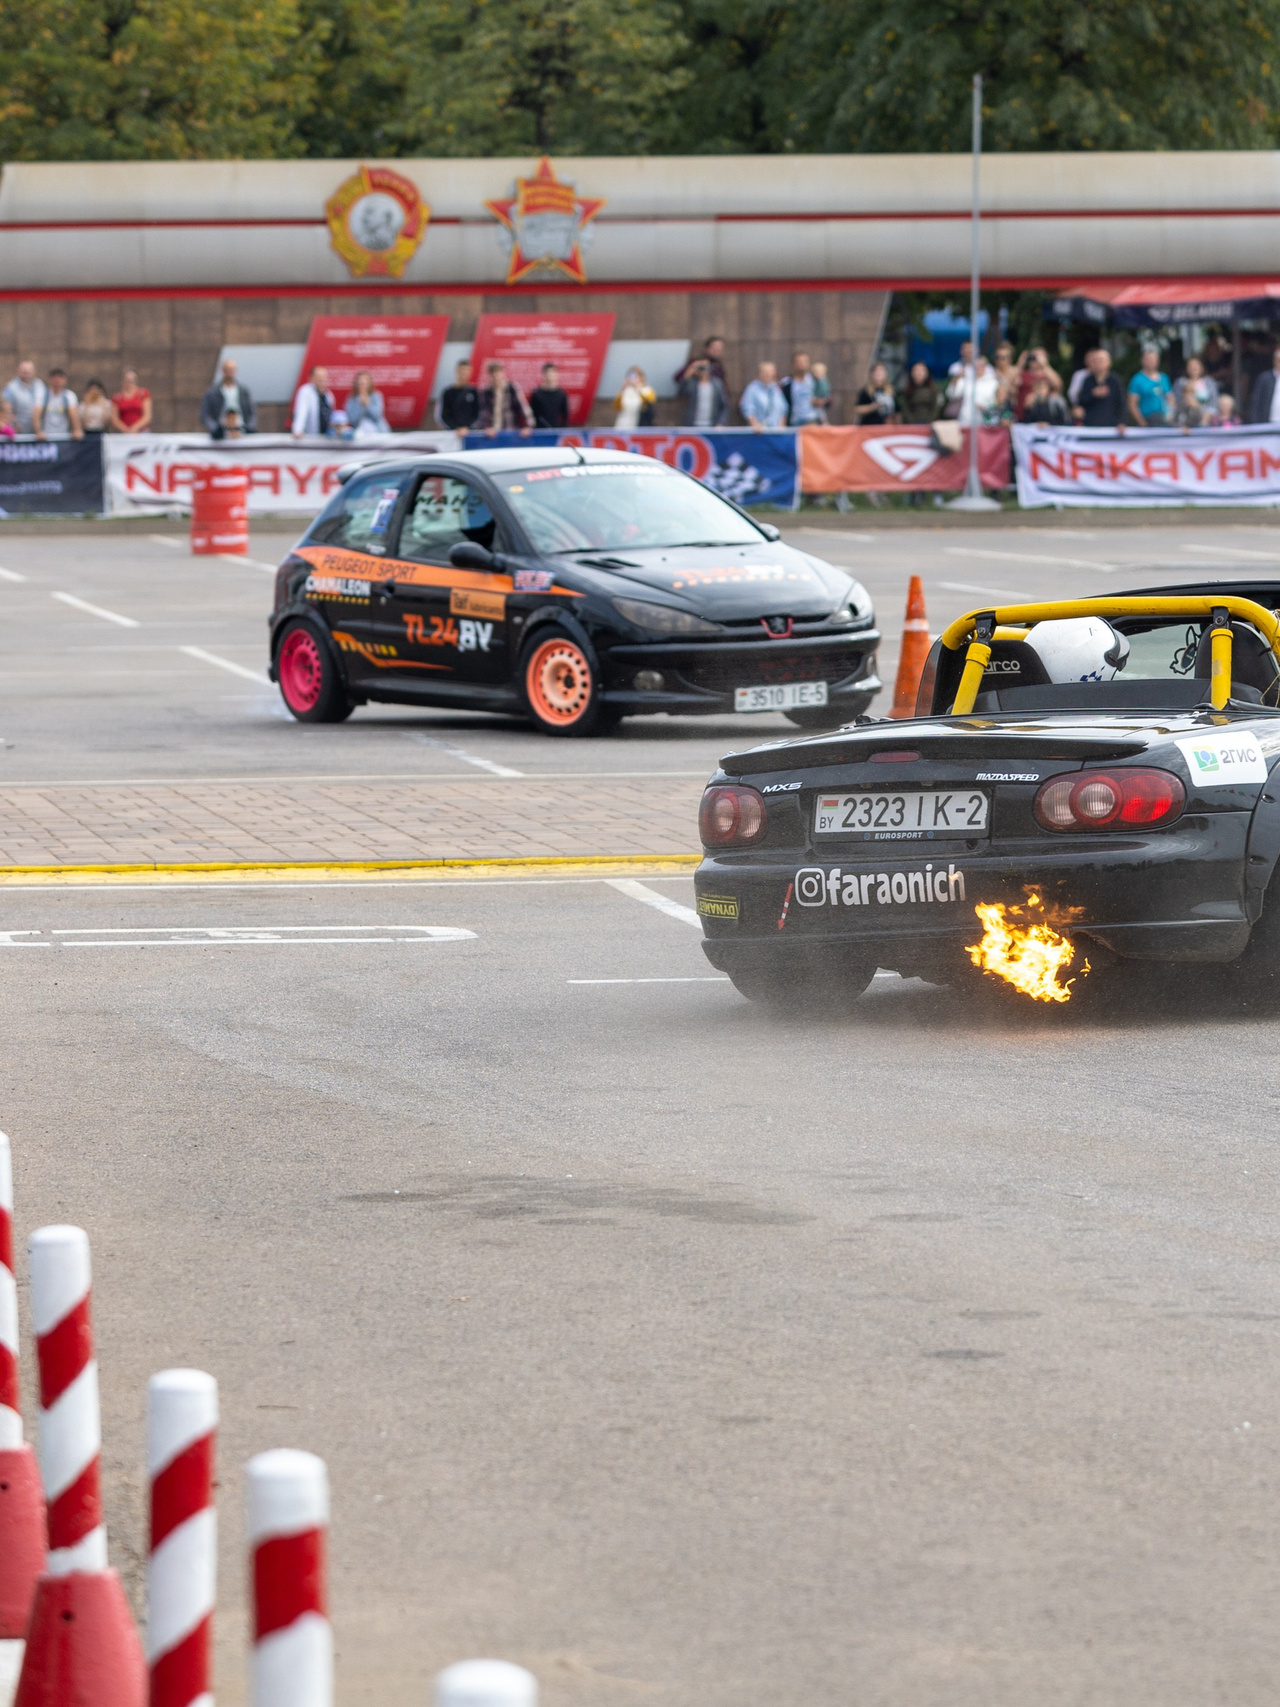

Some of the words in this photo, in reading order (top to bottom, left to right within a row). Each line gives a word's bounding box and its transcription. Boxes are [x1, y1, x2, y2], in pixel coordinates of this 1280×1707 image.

[321, 554, 377, 575] PEUGEOT
[376, 562, 418, 580] SPORT
[751, 688, 785, 707] 3510
[792, 684, 824, 704] IE-5
[1220, 748, 1257, 764] 2ГИС
[976, 773, 1040, 782] MAZDASPEED
[762, 782, 802, 793] MX5
[819, 816, 833, 829] BY
[841, 796, 905, 828] 2323
[875, 831, 923, 840] EUROSPORT
[826, 864, 966, 906] faraonich
